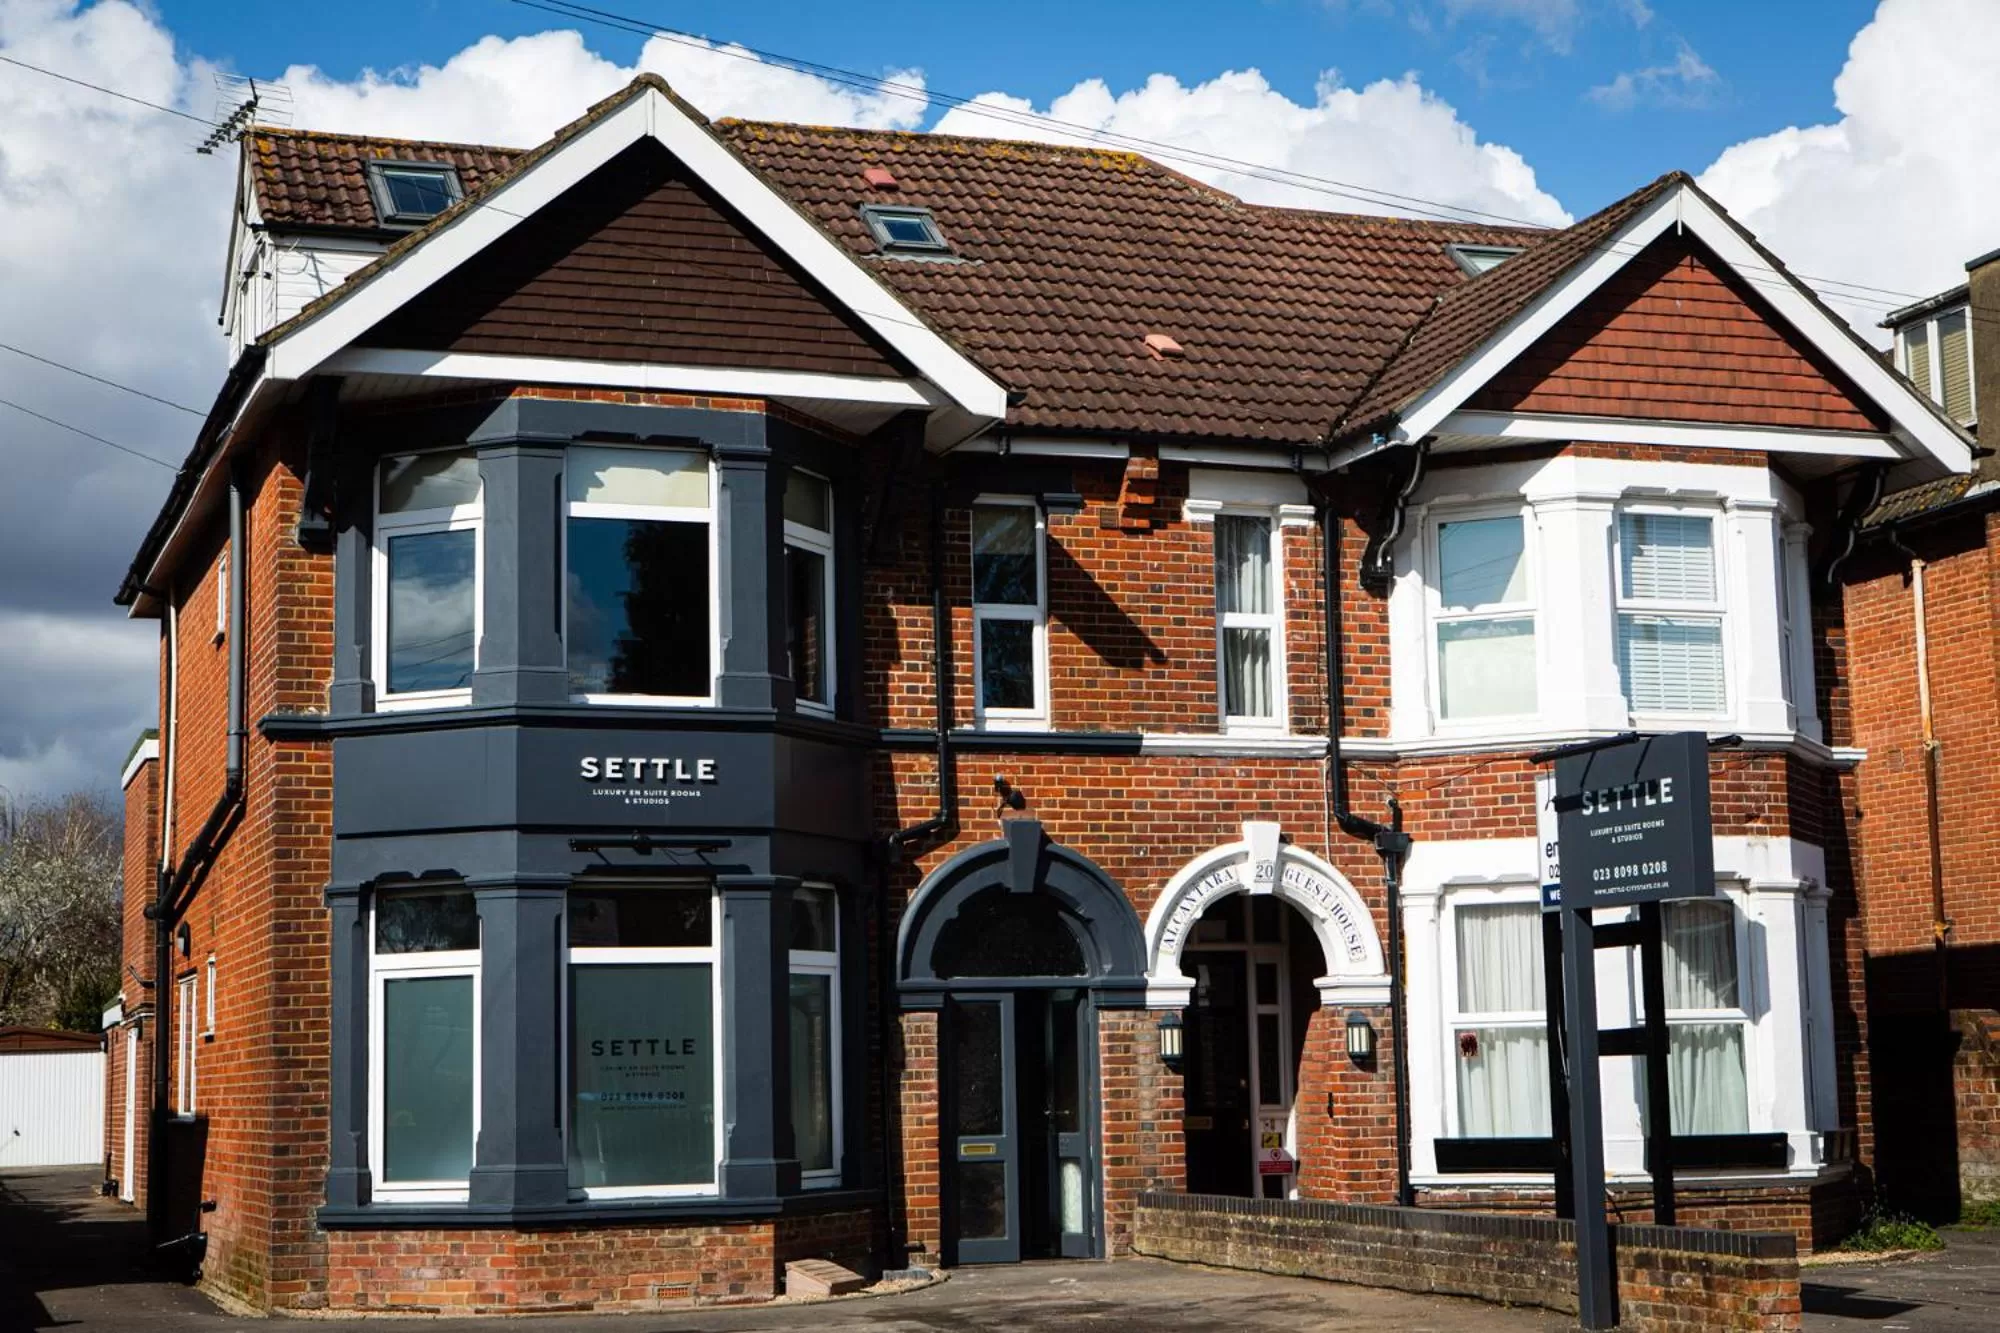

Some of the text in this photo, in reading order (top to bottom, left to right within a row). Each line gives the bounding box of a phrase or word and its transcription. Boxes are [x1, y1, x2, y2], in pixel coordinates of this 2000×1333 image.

[580, 757, 715, 780] SETTLE
[1581, 777, 1673, 815] SETTLE
[1590, 819, 1665, 837] LUXURY EN SUITE ROOMS
[1617, 833, 1643, 843] STUDIOS
[1593, 860, 1668, 881] 023 8098 0208
[1163, 864, 1364, 957] ALCANTARA 20 GUEST HOUSE
[591, 1039, 696, 1057] SETTLE
